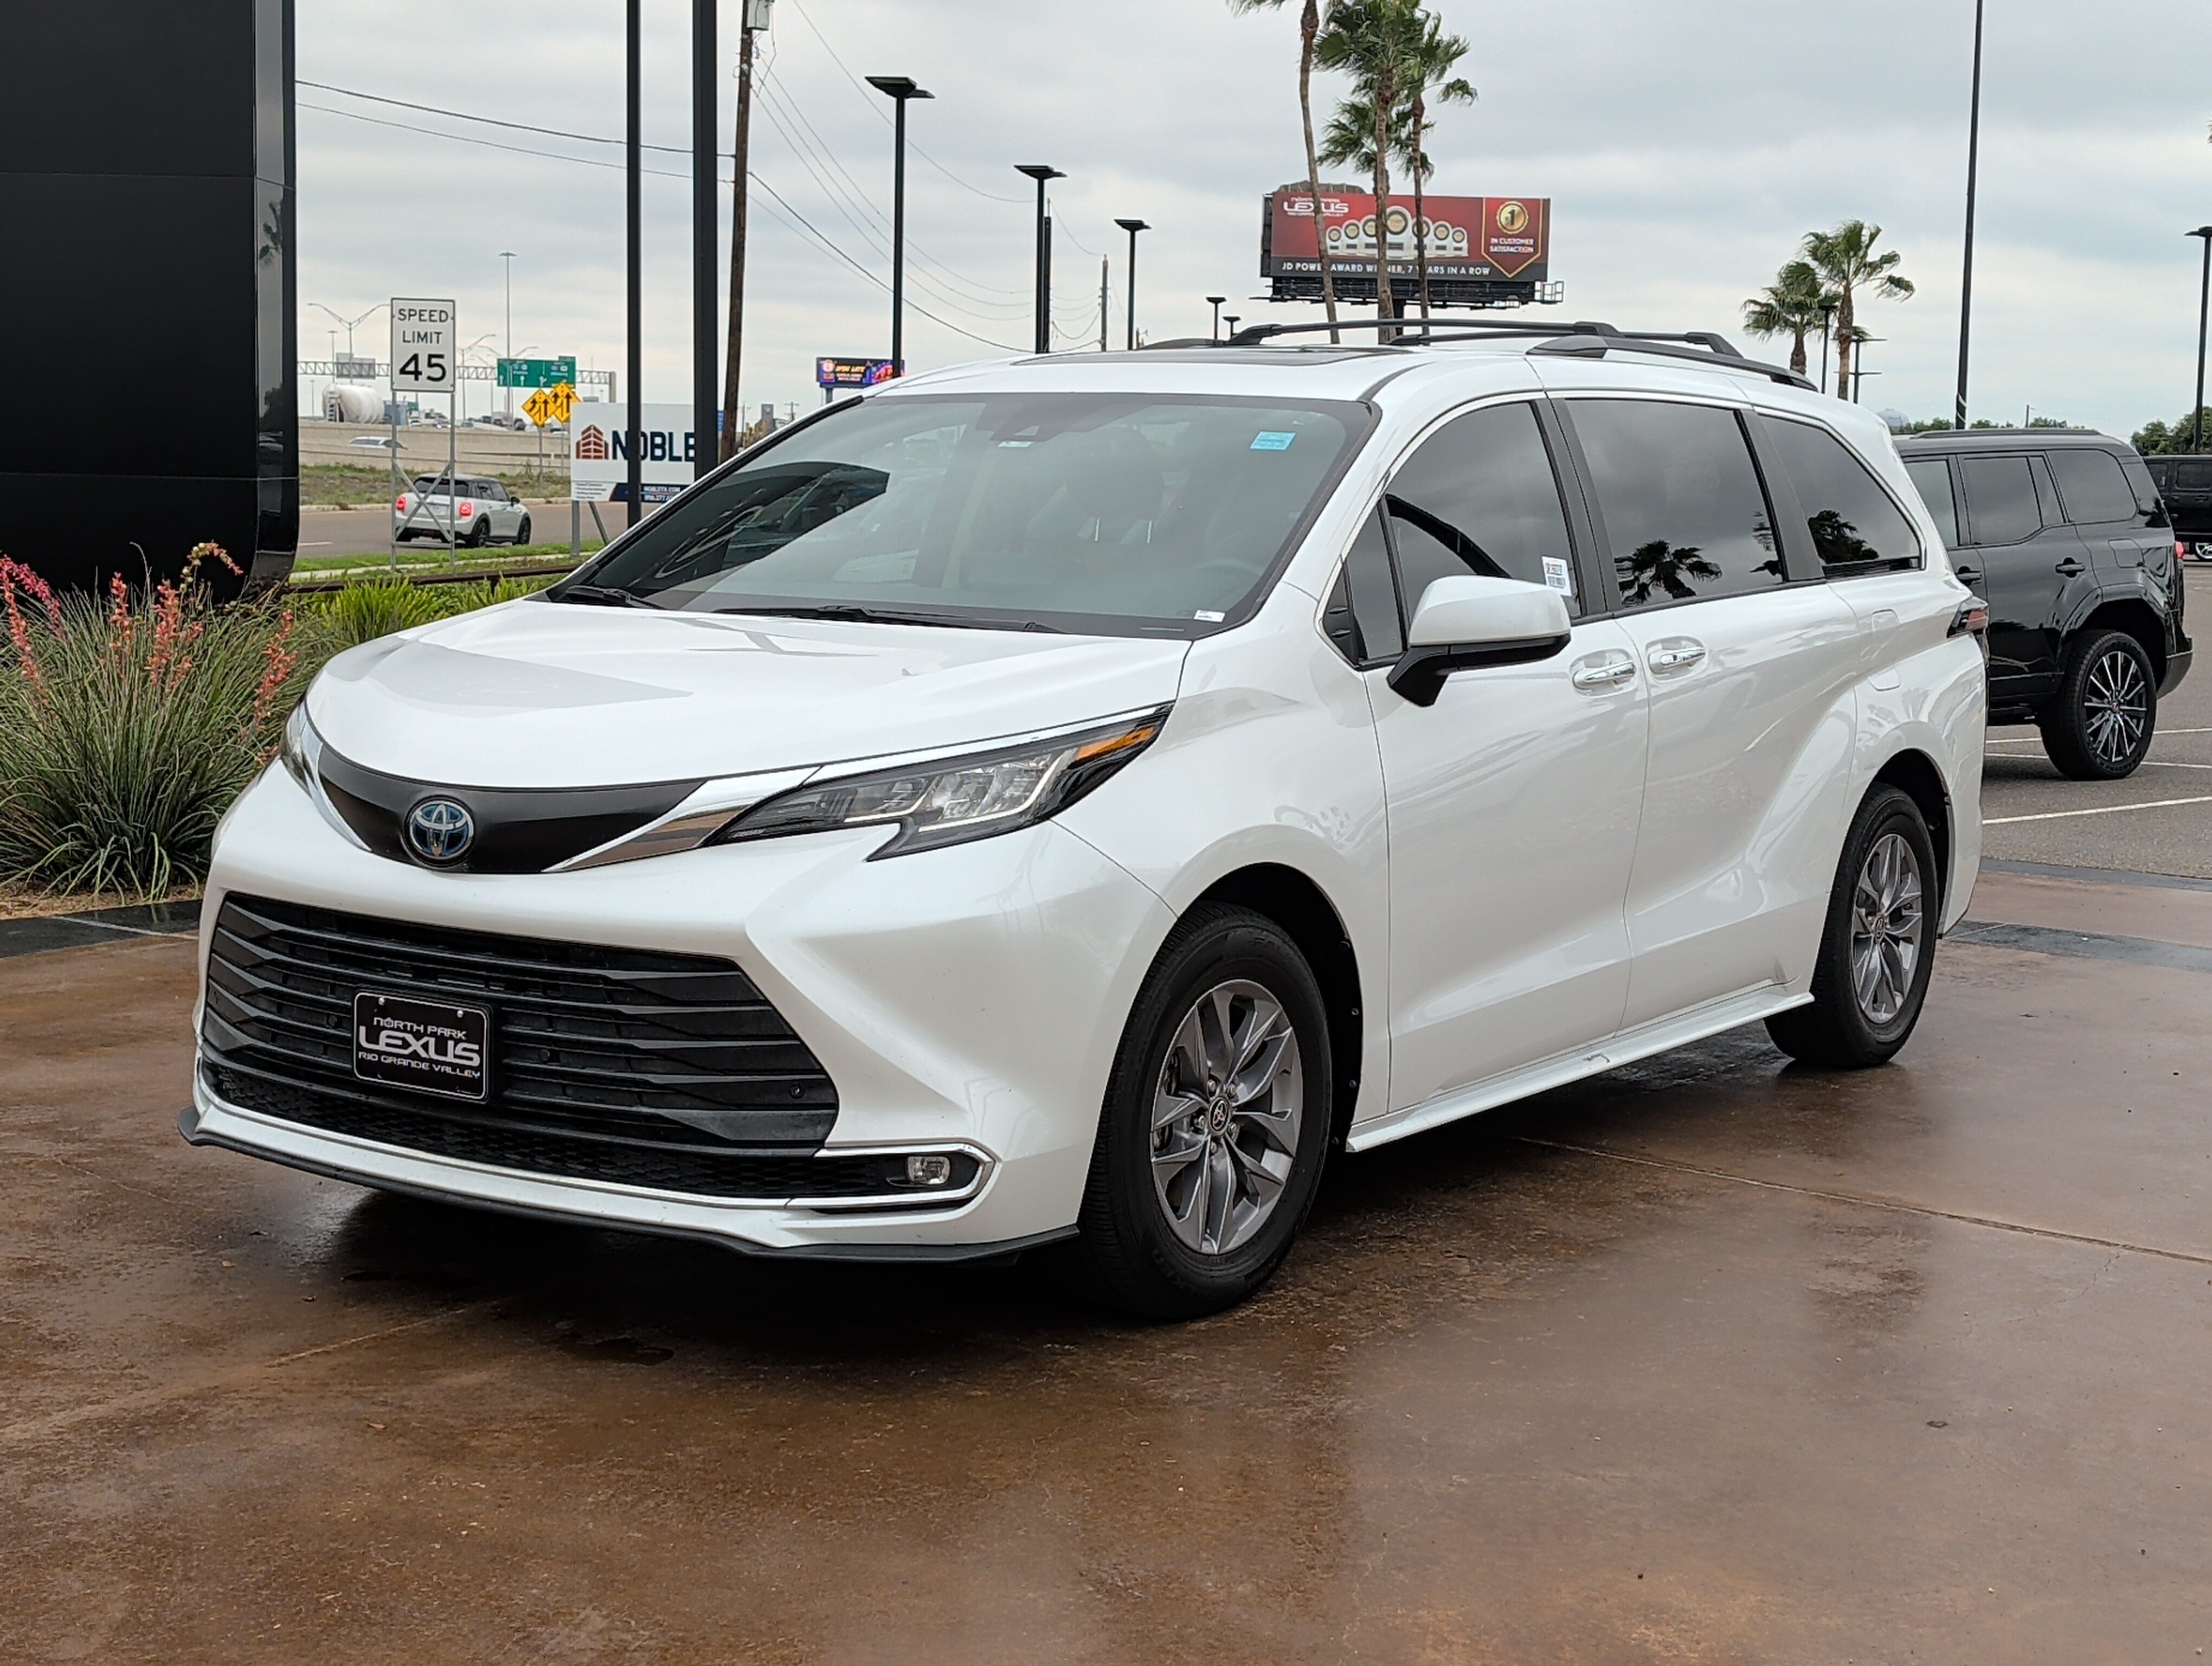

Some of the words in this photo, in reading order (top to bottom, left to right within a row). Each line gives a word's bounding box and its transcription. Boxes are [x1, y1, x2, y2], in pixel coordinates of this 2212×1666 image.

[1283, 201, 1349, 214] LEUS
[1282, 262, 1293, 271] JD
[1295, 262, 1322, 271] POWE
[1330, 263, 1363, 272] AWARD
[1366, 264, 1405, 274] WIER,
[1407, 265, 1413, 273] 7
[1416, 266, 1444, 274] ARS
[1447, 266, 1457, 274] IN
[1460, 266, 1467, 274] A
[1469, 267, 1490, 275] ROW
[397, 308, 449, 323] SPEED
[402, 330, 443, 344] LIMIT
[399, 353, 447, 382] 45
[373, 1017, 424, 1034] NORTH
[427, 1025, 467, 1041] PARK
[359, 1025, 480, 1067] LEXUS
[358, 1051, 378, 1061] RIO
[381, 1055, 430, 1071] GRANDE
[432, 1064, 480, 1079] VALLEY
